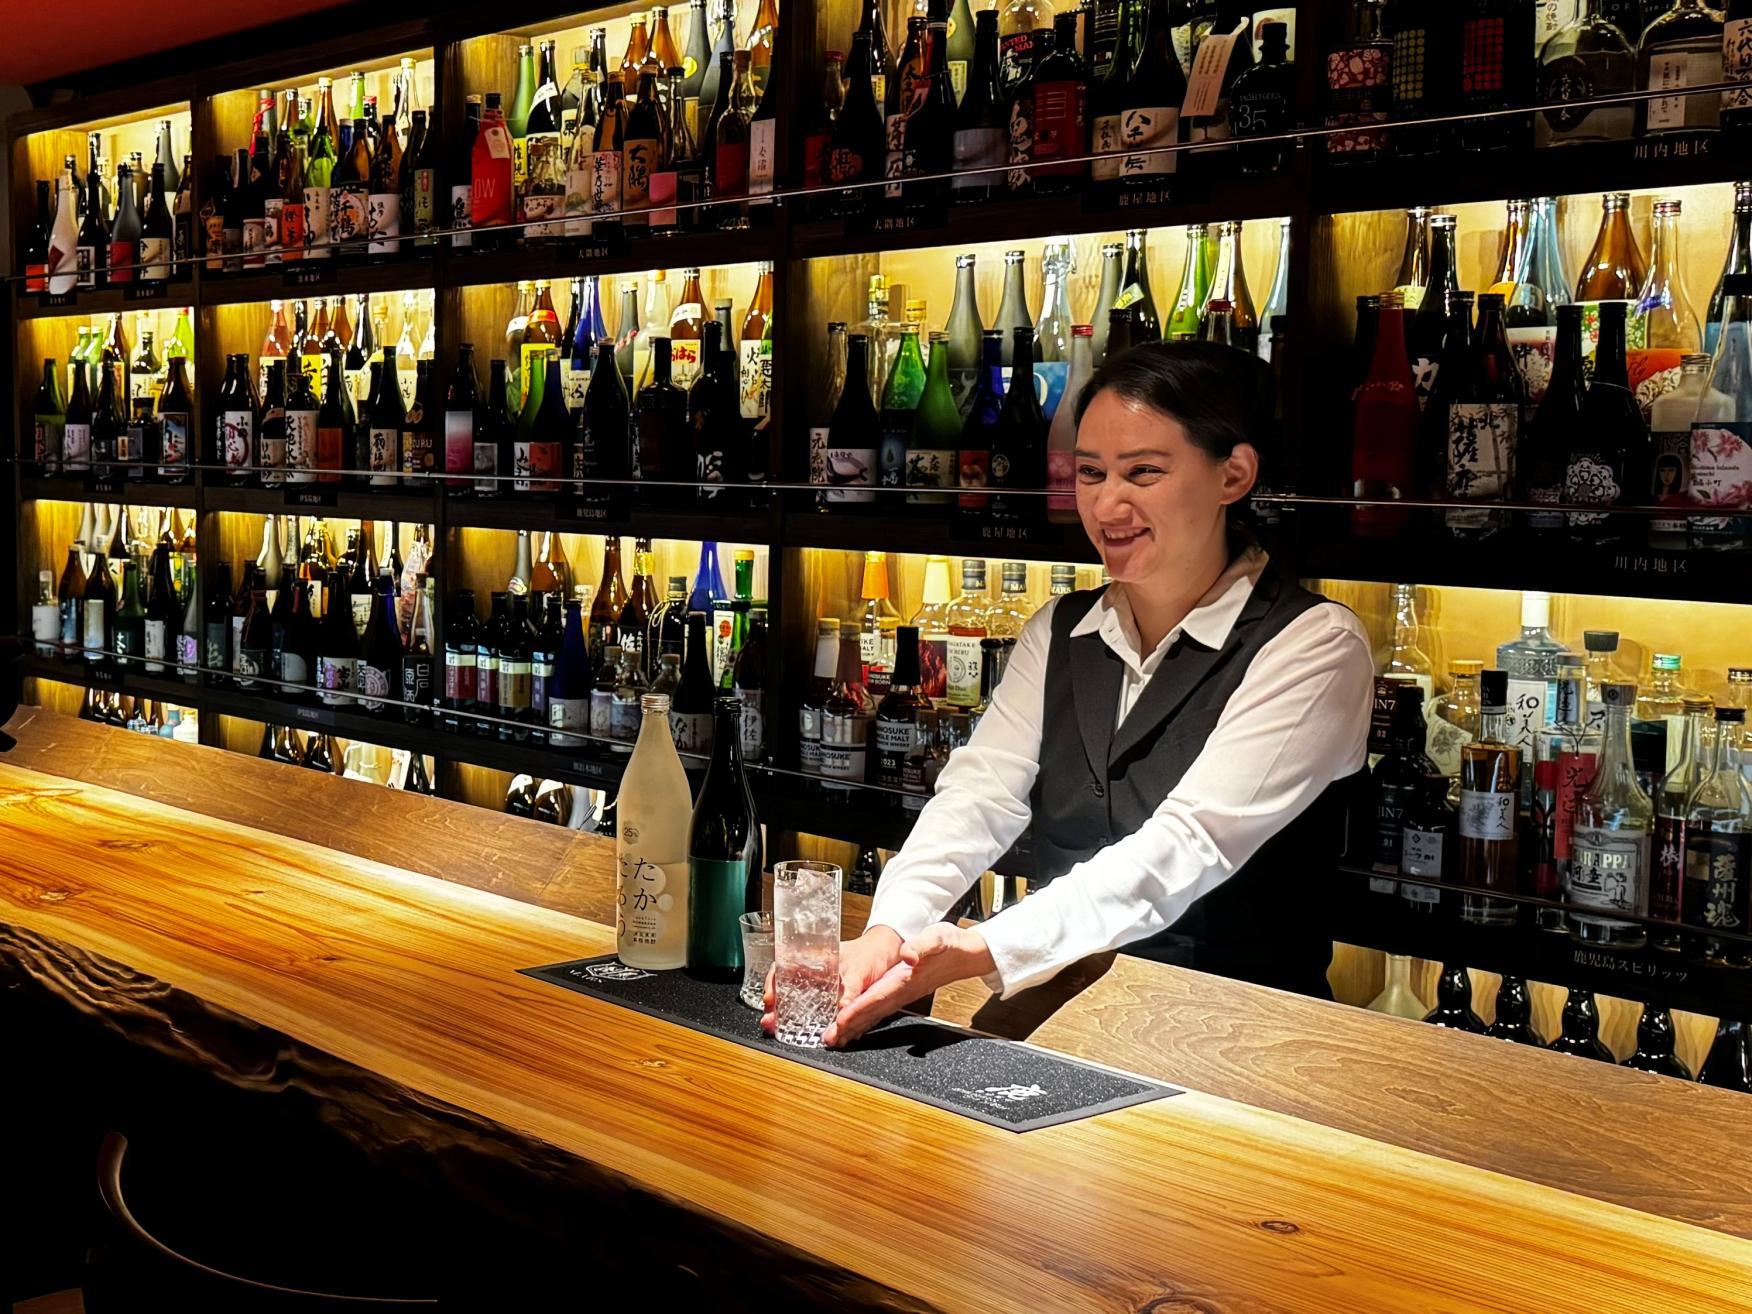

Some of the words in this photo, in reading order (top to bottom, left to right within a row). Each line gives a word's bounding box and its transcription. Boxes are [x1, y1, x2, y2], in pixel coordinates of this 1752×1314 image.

[1634, 138, 1710, 159] 川内地区
[1374, 698, 1397, 711] IN7
[633, 857, 657, 911] たか
[1573, 949, 1688, 982] 鹿児島スピリッツ
